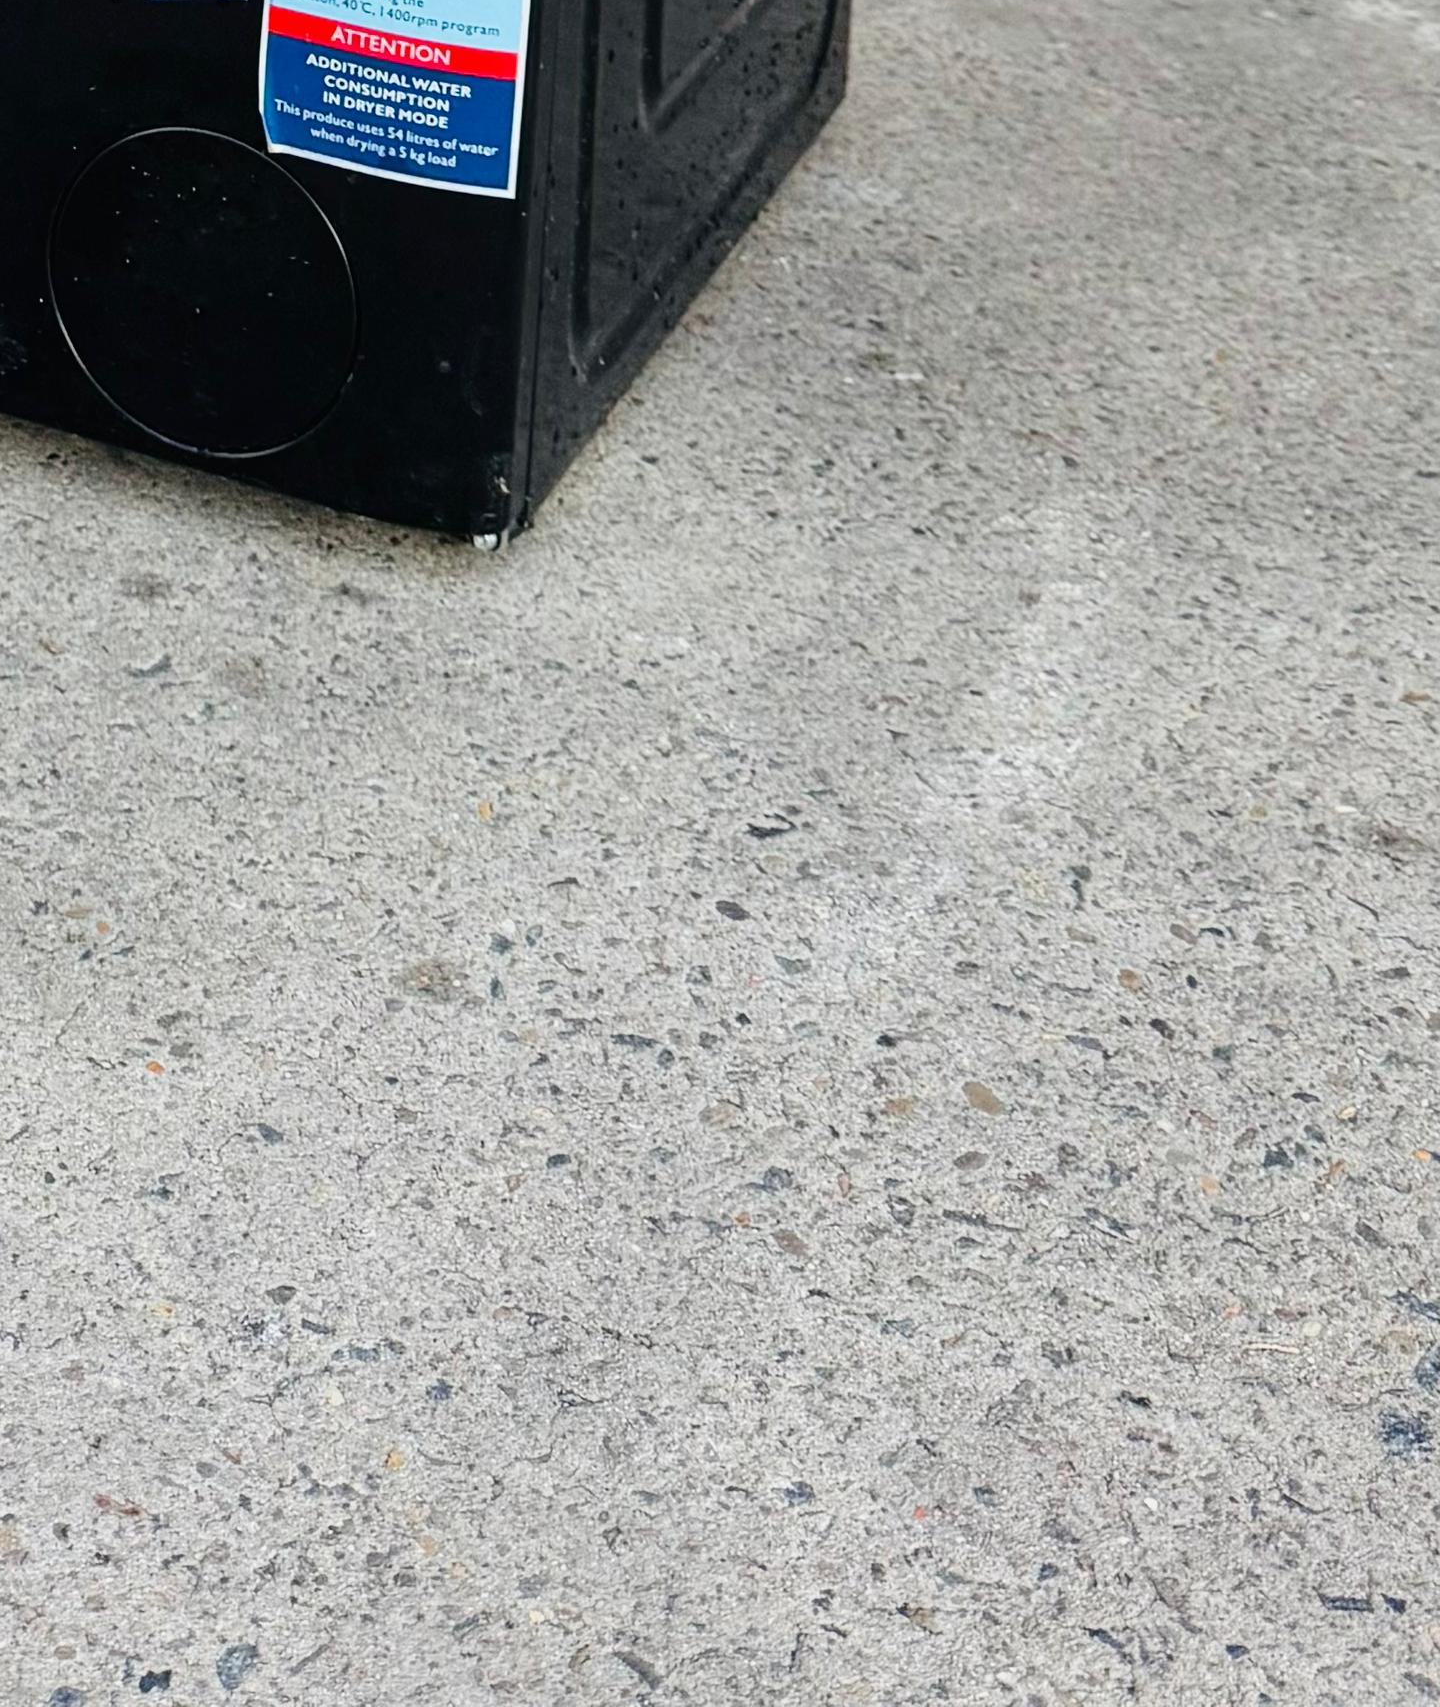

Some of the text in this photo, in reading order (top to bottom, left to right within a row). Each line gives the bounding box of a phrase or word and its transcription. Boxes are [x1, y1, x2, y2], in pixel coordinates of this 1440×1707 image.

[379, 5, 438, 28] 1400rpm
[441, 18, 501, 38] program
[331, 25, 451, 66] ATTENTION
[306, 52, 472, 99] ADDITIONAL WATER
[324, 74, 450, 112] CONSUMPTION
[274, 98, 499, 157] This produce uses 54 litres of water
[323, 90, 449, 130] IN DRYER MODE
[310, 125, 456, 168] when drying a 5 kg load
